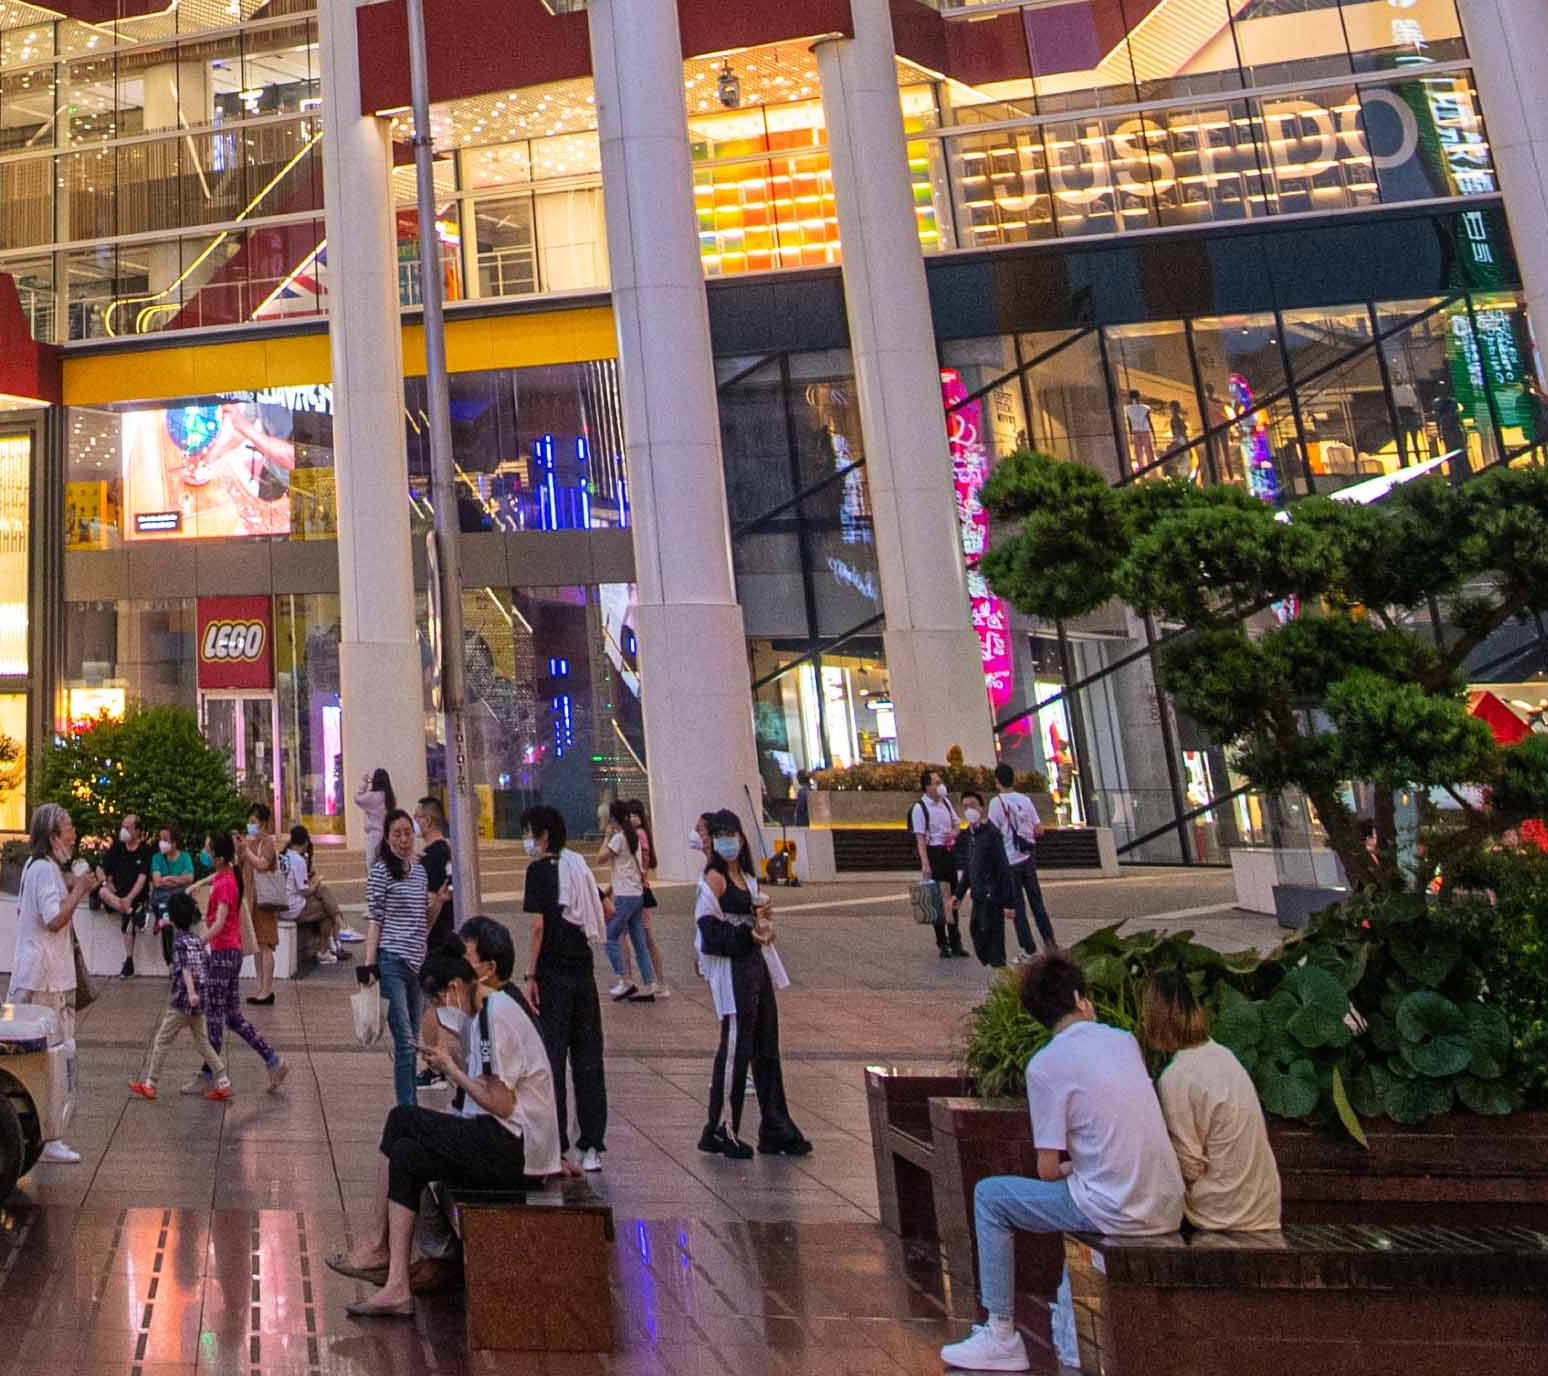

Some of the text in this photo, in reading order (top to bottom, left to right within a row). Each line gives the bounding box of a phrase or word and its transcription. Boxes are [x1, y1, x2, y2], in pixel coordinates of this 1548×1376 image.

[993, 89, 1418, 212] JUST DO
[203, 622, 264, 660] LEGO
